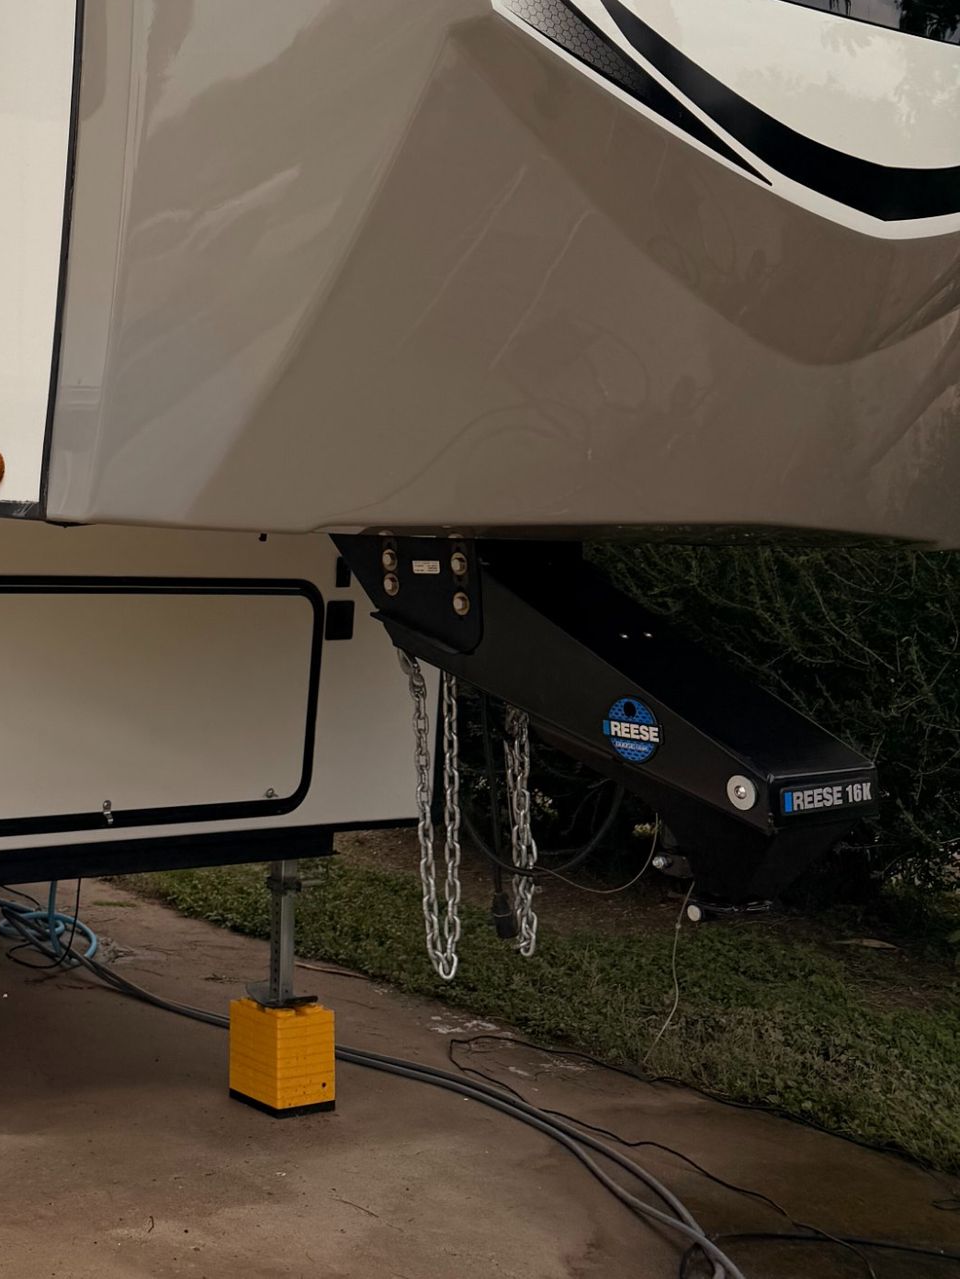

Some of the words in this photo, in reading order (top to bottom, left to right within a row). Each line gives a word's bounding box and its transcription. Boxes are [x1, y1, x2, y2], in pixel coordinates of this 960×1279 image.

[610, 720, 660, 743] REESE
[792, 785, 844, 812] REESE
[845, 782, 872, 804] 16K
